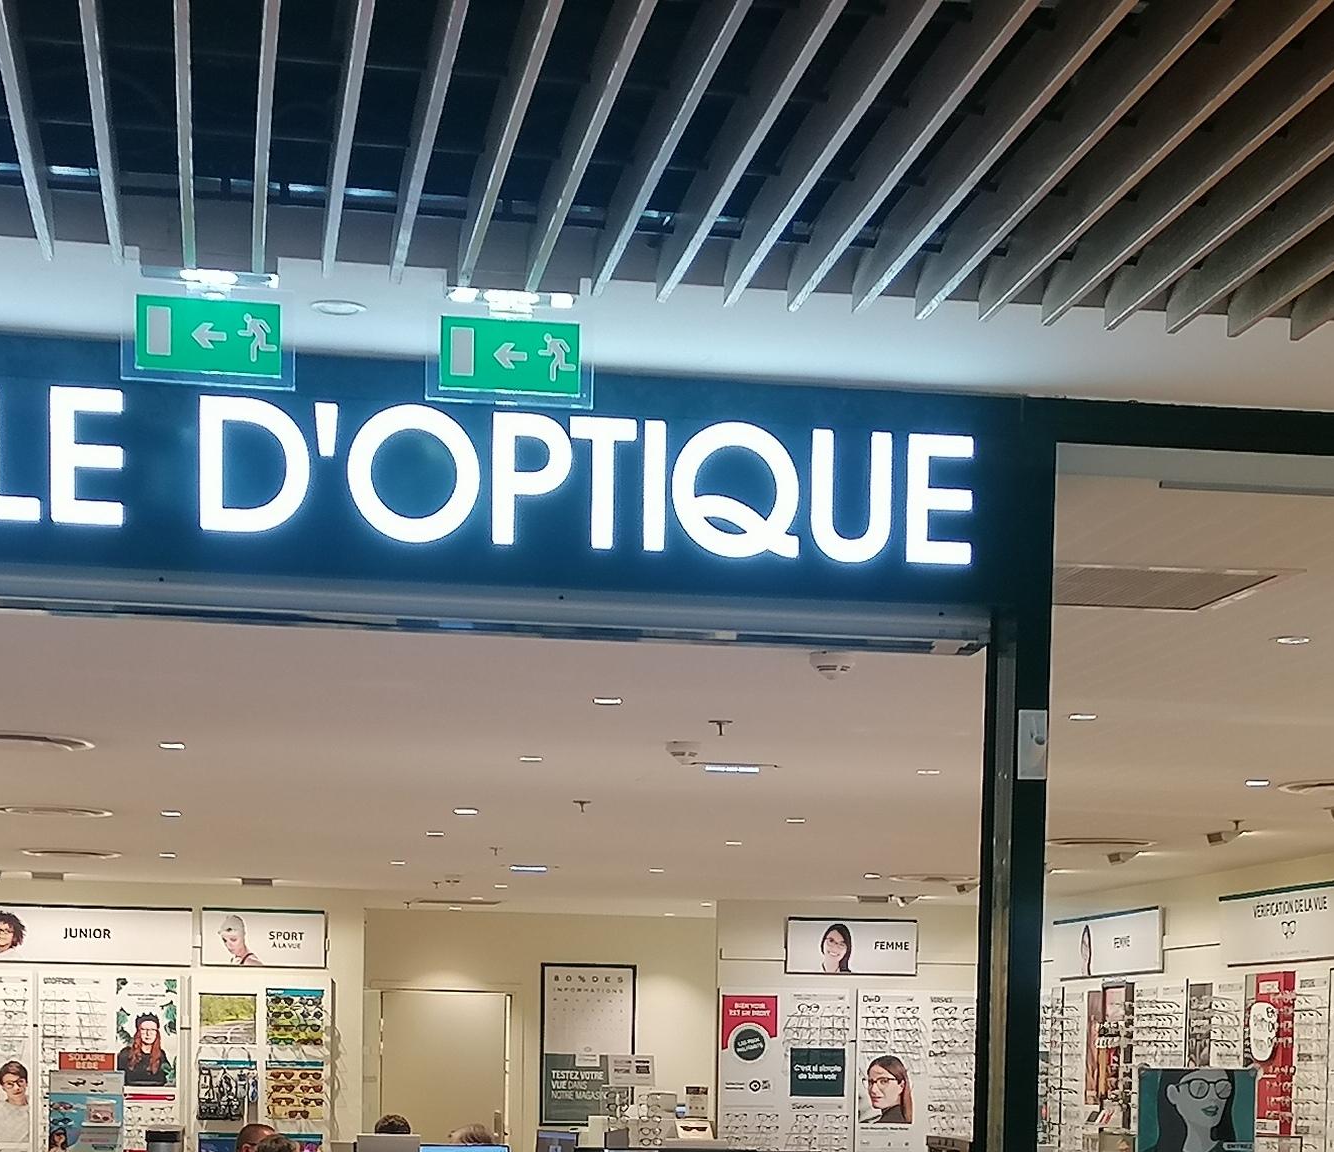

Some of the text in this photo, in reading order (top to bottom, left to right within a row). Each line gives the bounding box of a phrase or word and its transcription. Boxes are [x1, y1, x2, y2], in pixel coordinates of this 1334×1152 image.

[198, 394, 974, 565] D'OPTIQUE
[63, 927, 111, 940] JUNIOR
[268, 930, 304, 942] SPORT
[873, 941, 909, 951] FEMME
[551, 1070, 580, 1080] TESTEZ
[551, 1080, 567, 1090] VUE
